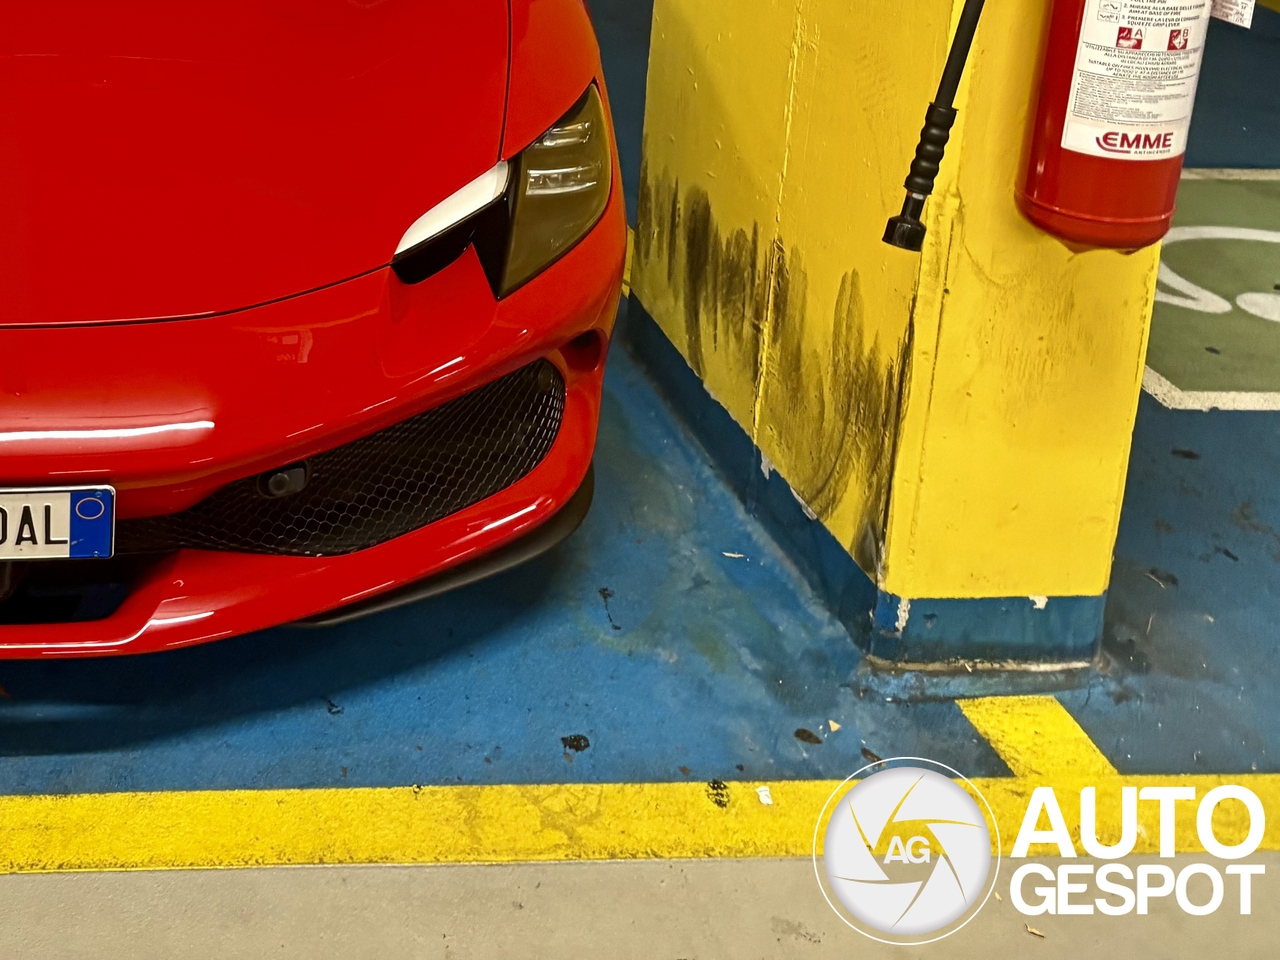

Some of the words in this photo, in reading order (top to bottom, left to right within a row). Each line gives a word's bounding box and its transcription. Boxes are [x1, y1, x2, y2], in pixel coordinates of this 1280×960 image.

[1134, 29, 1143, 37] A
[1183, 28, 1189, 38] B
[1102, 131, 1174, 150] EMME
